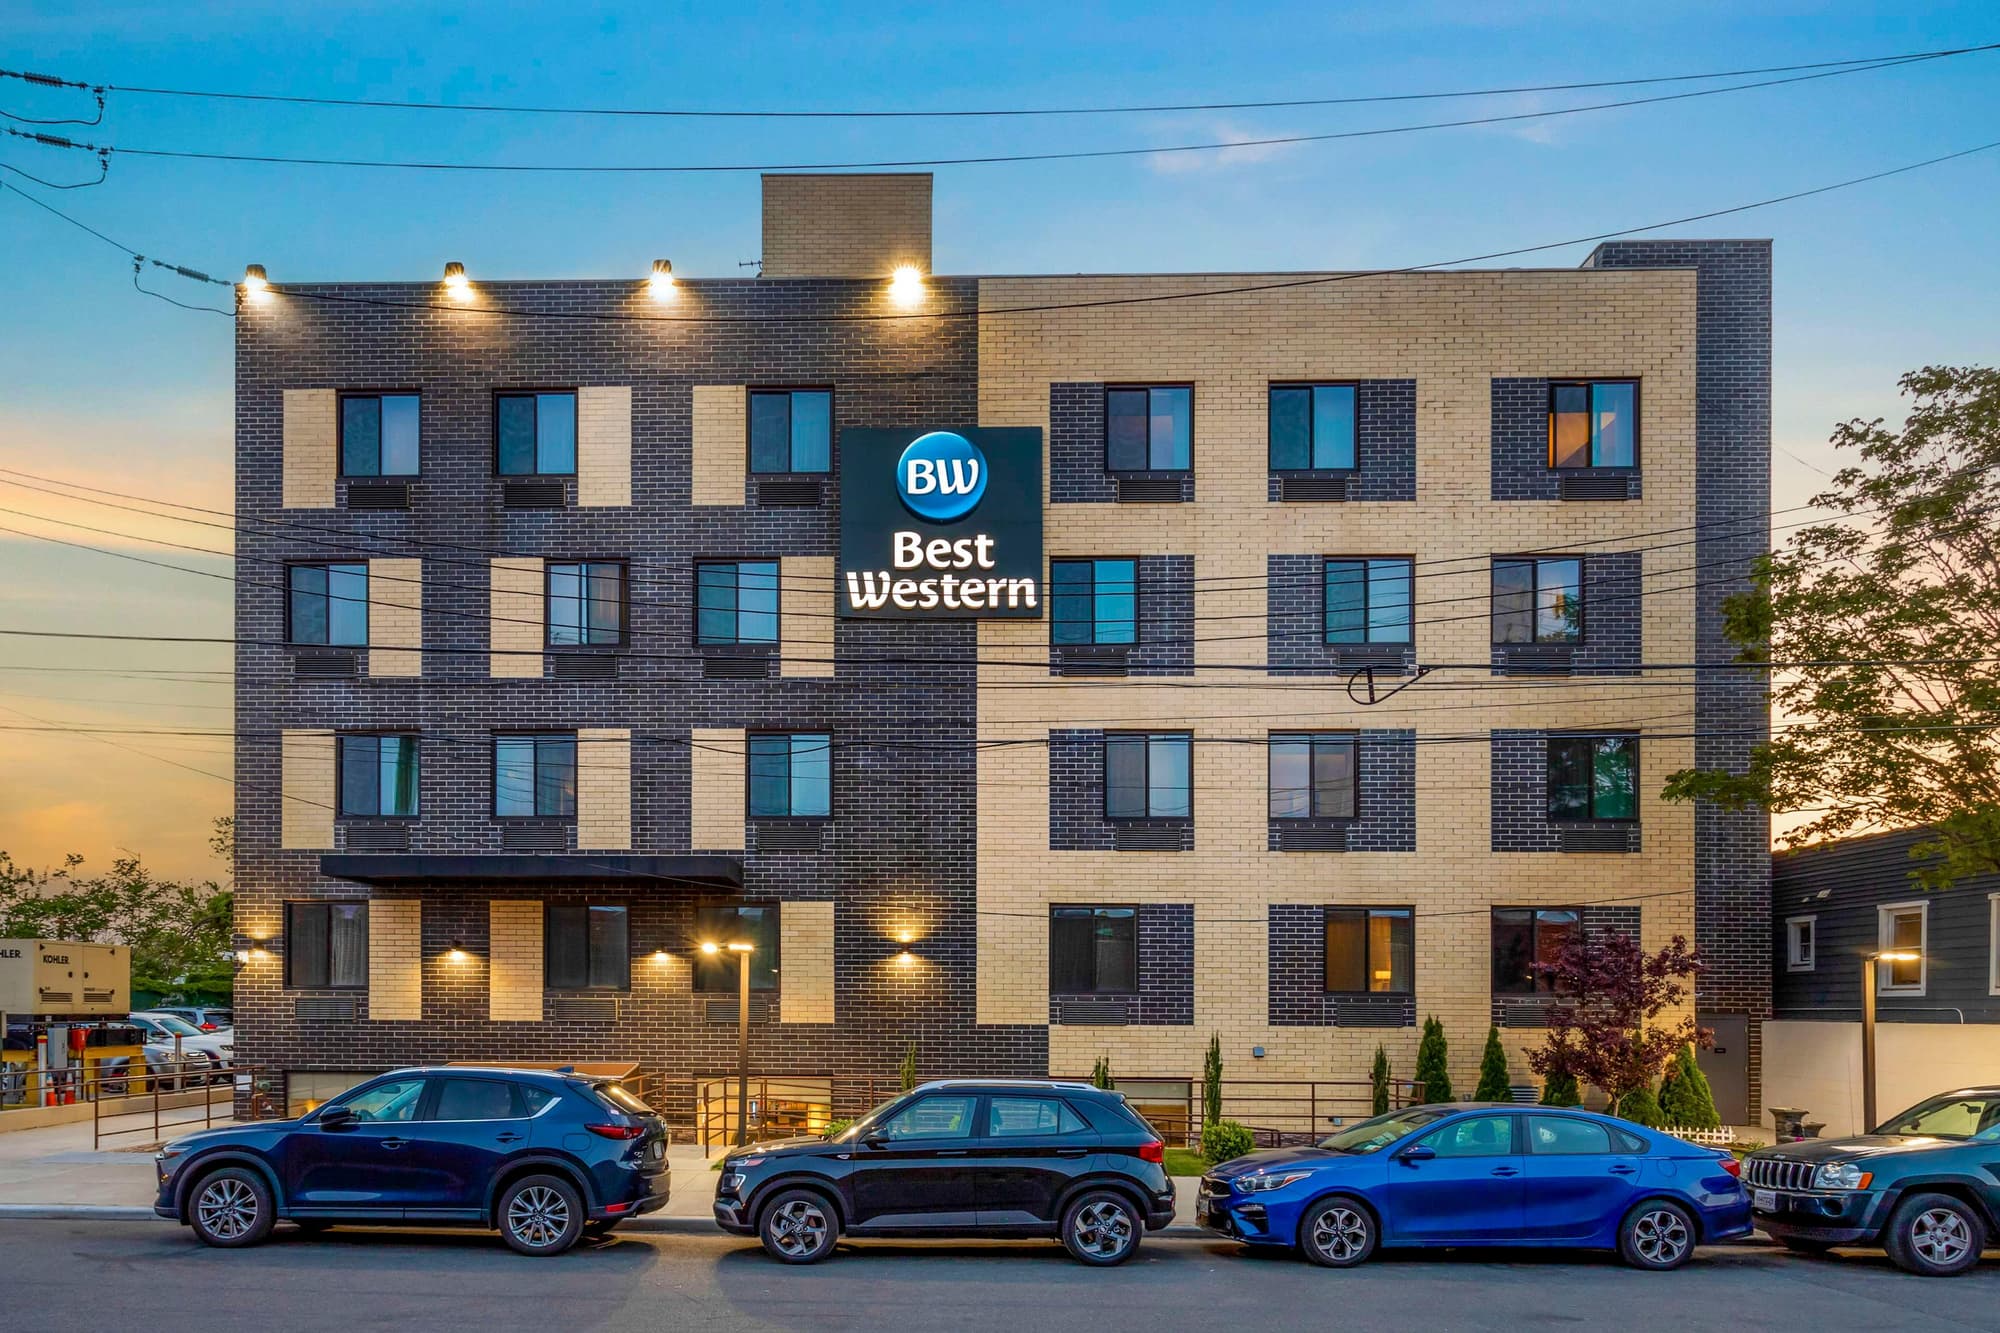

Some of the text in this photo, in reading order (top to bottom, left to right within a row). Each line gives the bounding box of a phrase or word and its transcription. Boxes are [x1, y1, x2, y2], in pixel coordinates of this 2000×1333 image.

[907, 458, 979, 495] BW
[893, 531, 995, 569] Best
[846, 570, 1038, 608] Western
[43, 954, 70, 965] KOHLER
